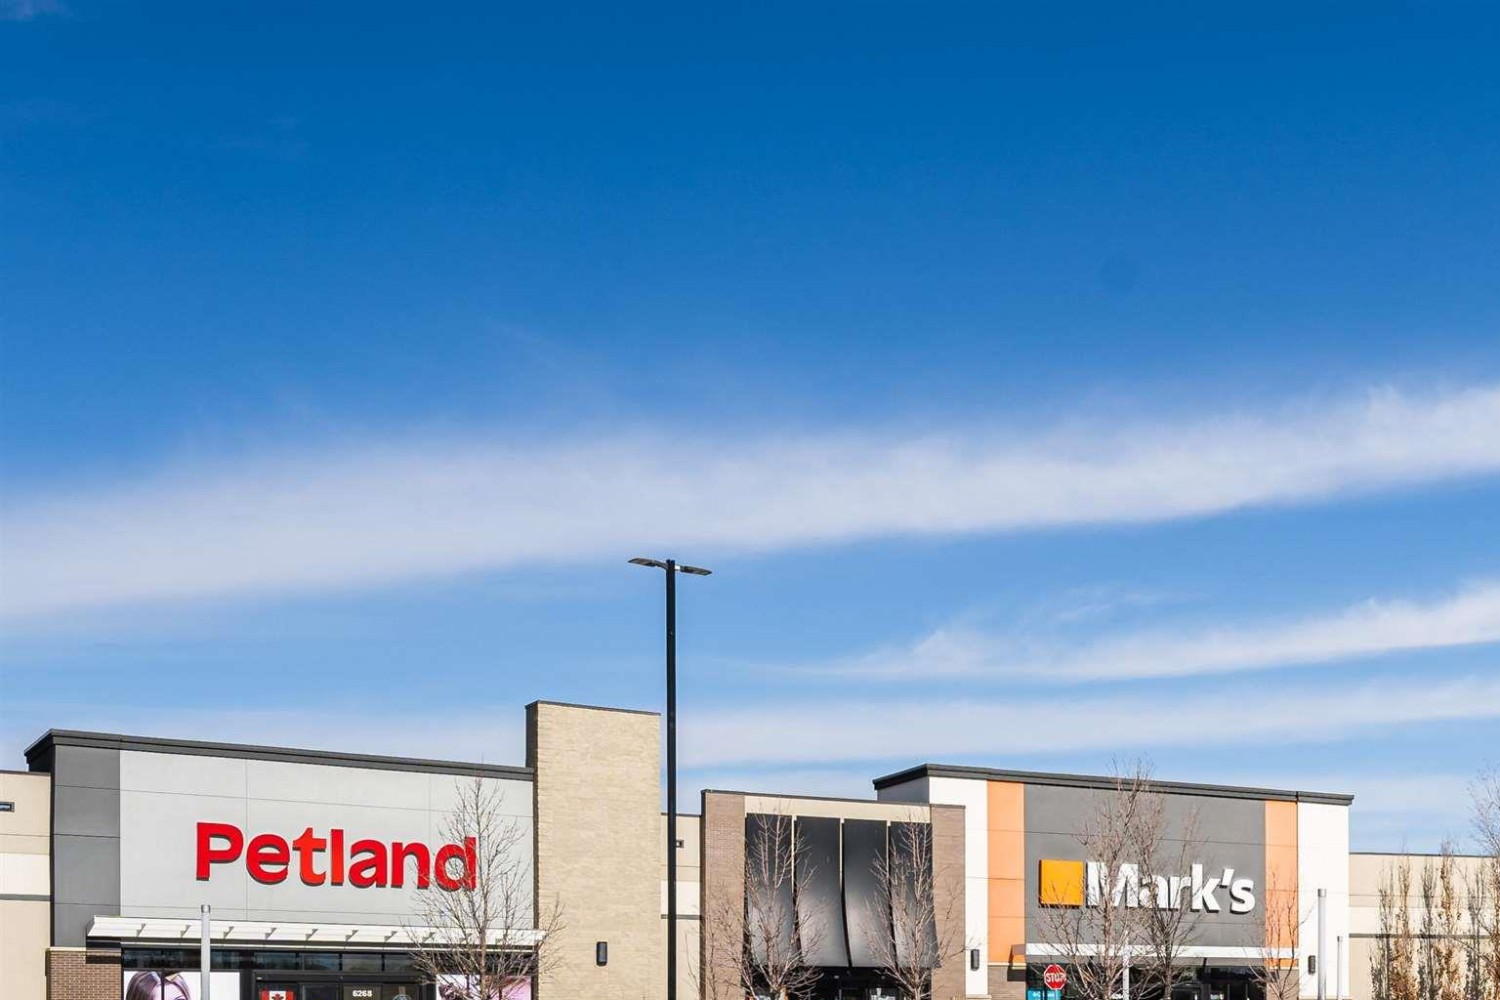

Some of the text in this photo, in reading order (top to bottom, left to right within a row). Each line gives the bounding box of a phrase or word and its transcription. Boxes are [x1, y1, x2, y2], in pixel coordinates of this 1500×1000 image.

[195, 822, 477, 892] Petland
[1086, 861, 1256, 914] Mark's
[1046, 972, 1066, 983] STOP
